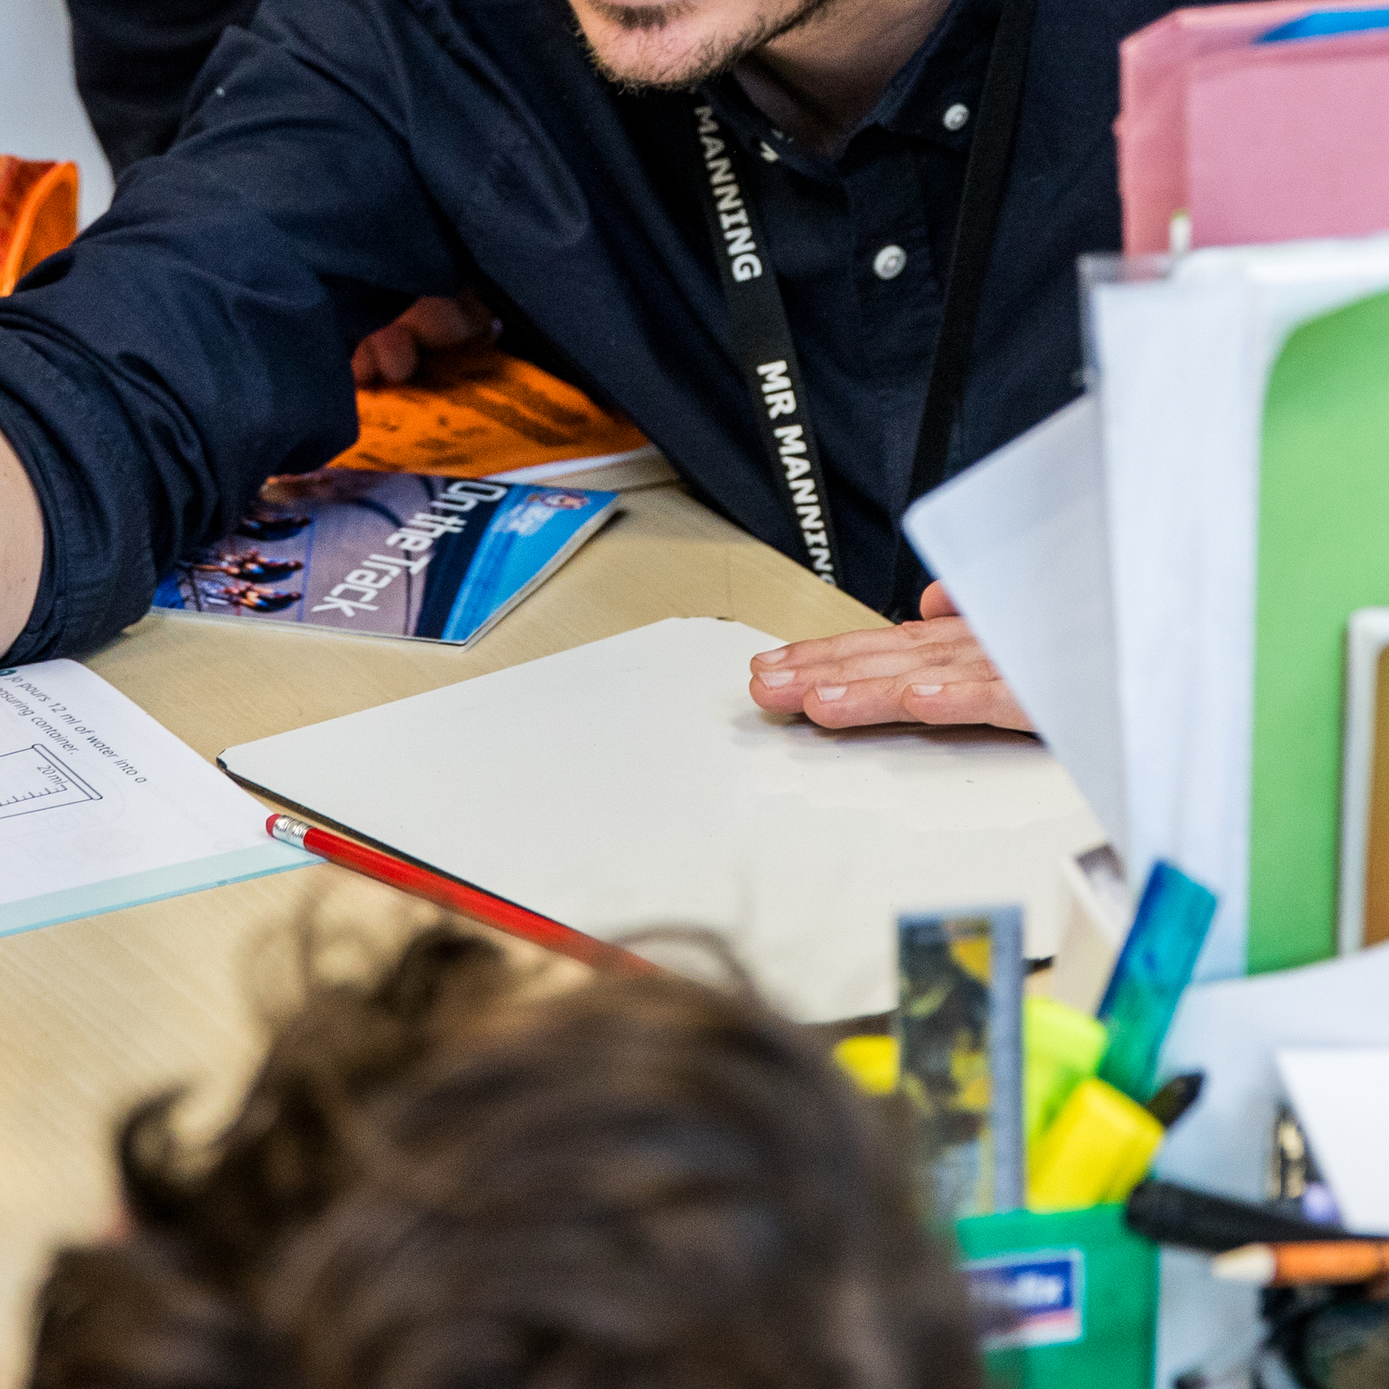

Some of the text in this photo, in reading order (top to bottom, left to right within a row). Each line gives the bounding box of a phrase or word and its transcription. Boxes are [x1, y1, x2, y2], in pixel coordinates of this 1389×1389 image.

[694, 106, 762, 282] MANNING
[756, 360, 798, 420] MR
[428, 479, 509, 512] On
[385, 511, 468, 552] the
[310, 553, 432, 619] Track
[15, 682, 51, 702] pours
[48, 702, 67, 713] 12
[60, 713, 82, 725] ml
[74, 725, 95, 735] of
[86, 735, 119, 758] water
[113, 758, 138, 776] into
[134, 776, 147, 784] a
[31, 716, 80, 755] container.
